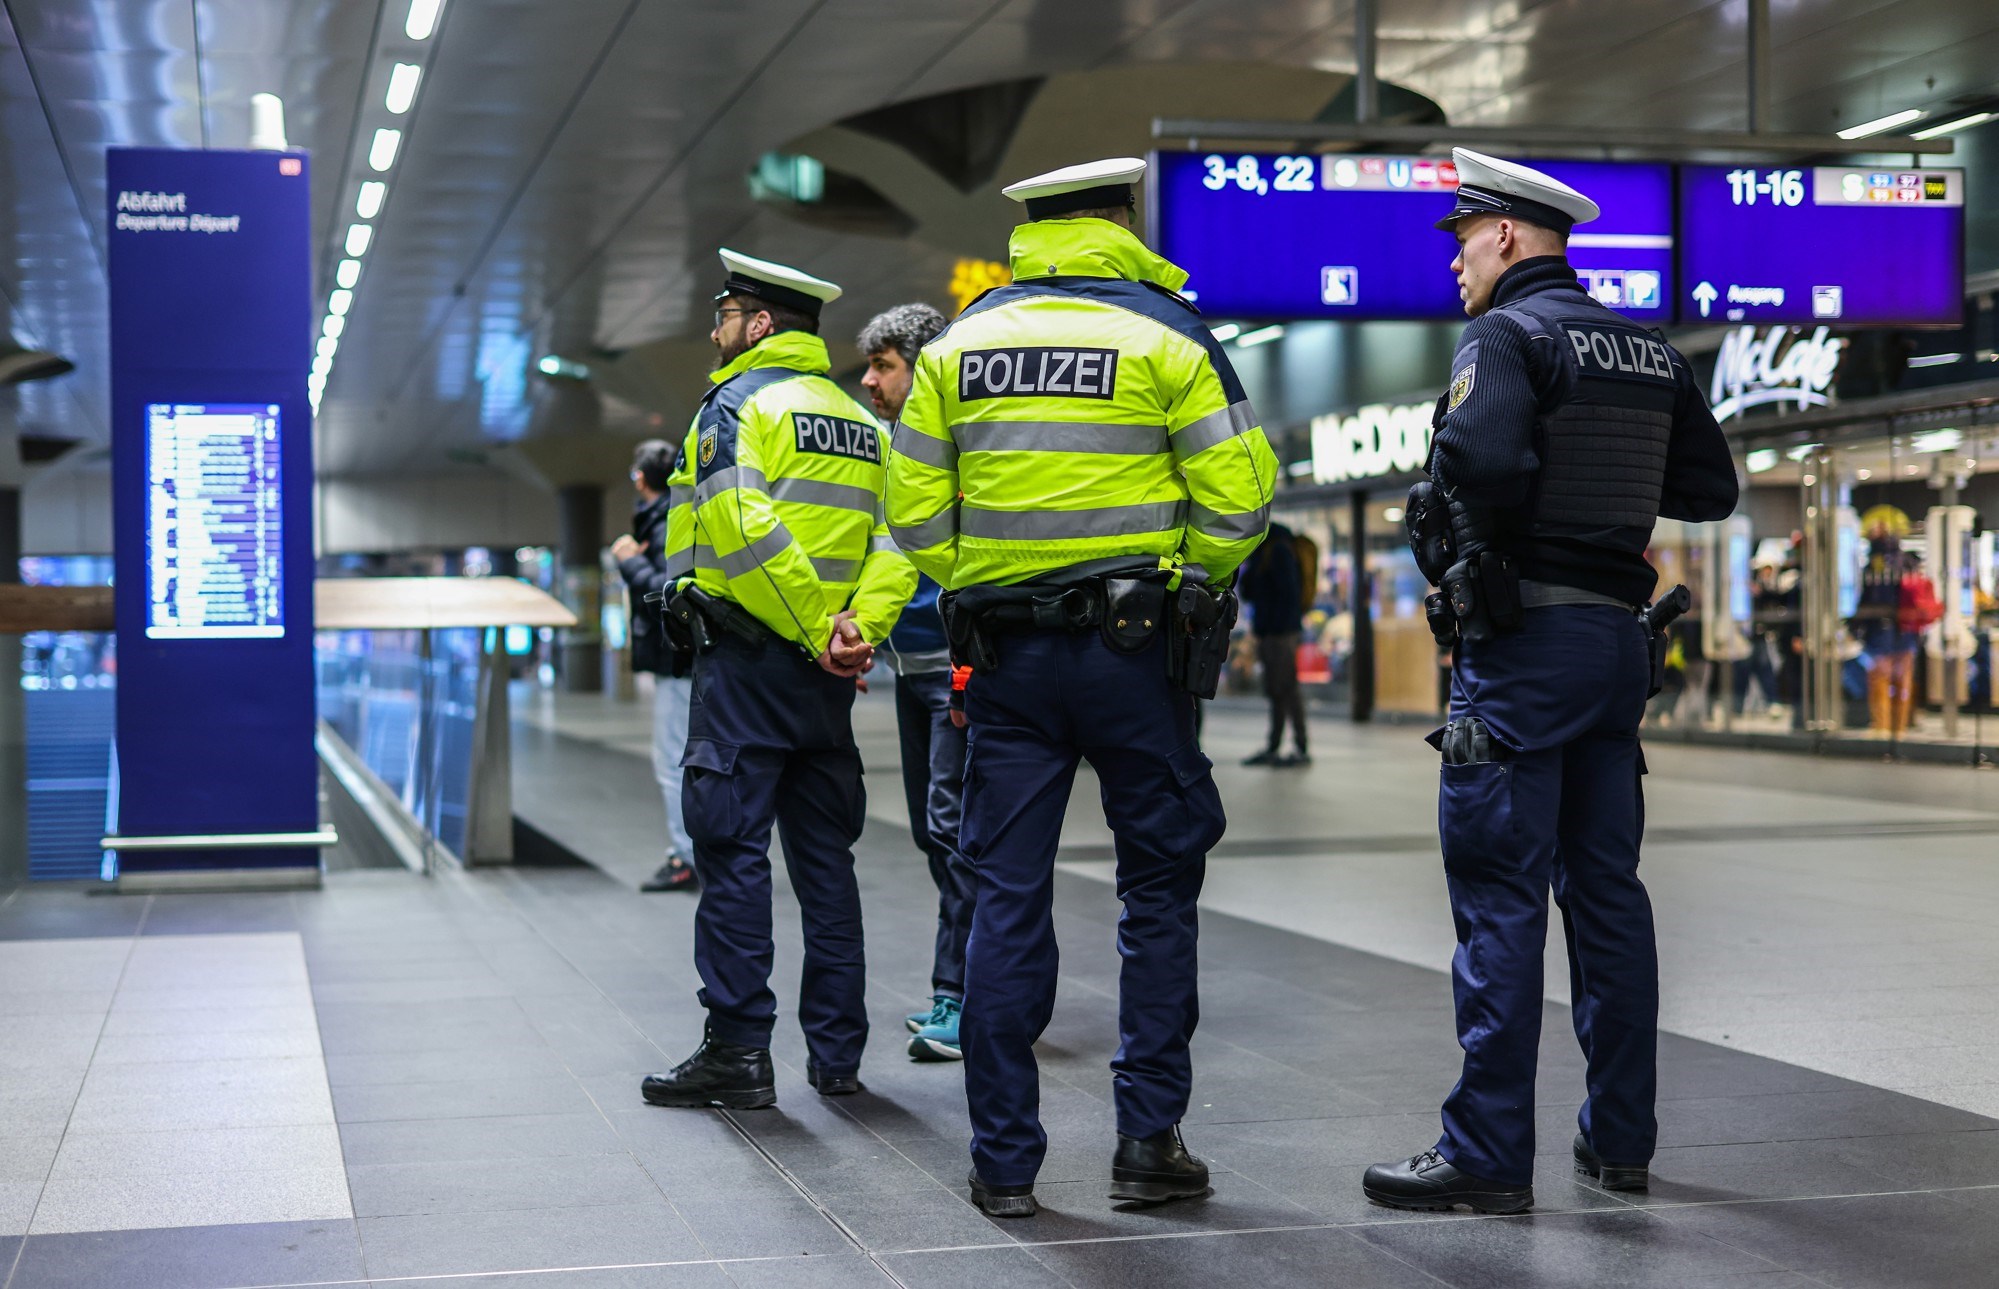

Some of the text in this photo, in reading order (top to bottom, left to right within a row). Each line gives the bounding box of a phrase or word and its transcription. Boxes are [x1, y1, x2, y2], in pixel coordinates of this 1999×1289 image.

[1203, 154, 1267, 197] 3-8,
[1273, 155, 1314, 192] 22
[1388, 159, 1410, 188] U
[1726, 169, 1805, 207] 11-16
[116, 191, 187, 212] Abfahrt
[962, 351, 1115, 396] POLIZEI
[1567, 329, 1675, 380] POLIZEI
[795, 416, 880, 462] POLIZEI
[1311, 401, 1437, 485] McDon
